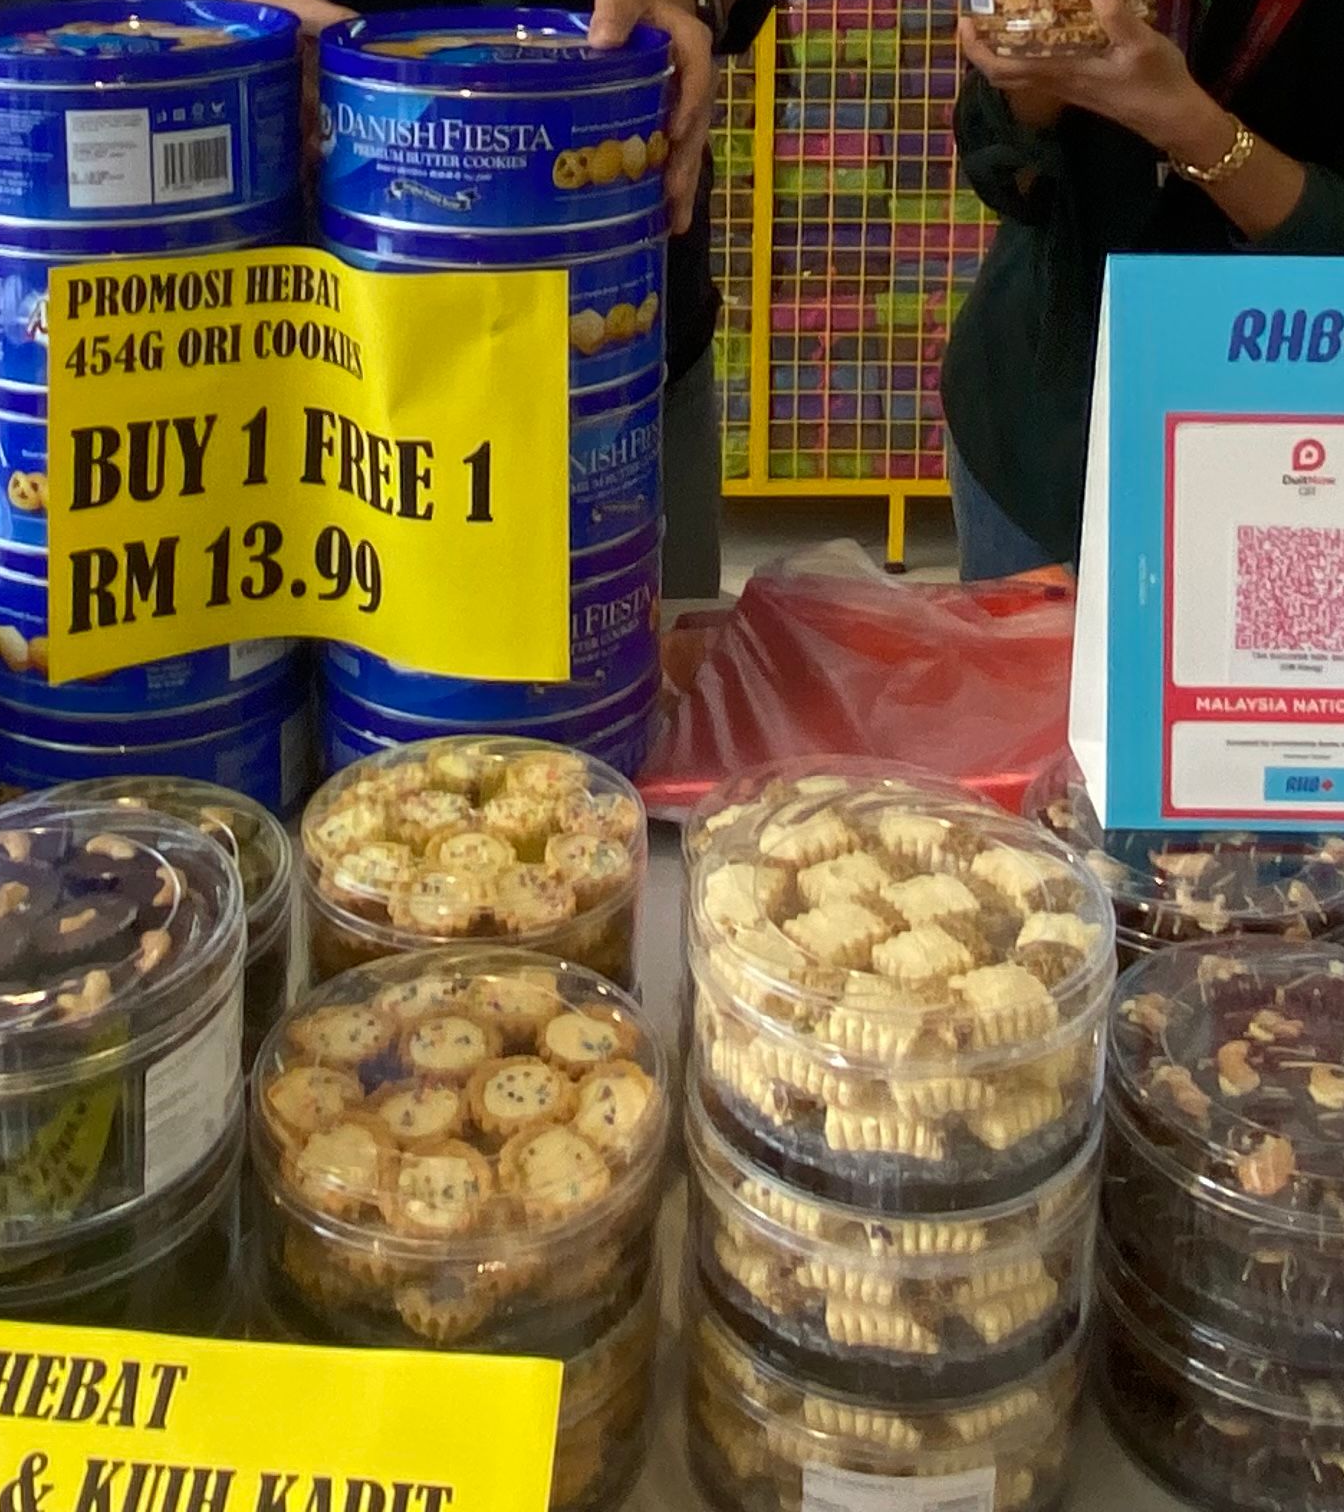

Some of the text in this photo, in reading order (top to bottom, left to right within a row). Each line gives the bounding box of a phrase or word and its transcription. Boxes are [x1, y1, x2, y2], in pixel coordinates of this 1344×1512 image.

[338, 100, 436, 151] DANISH
[441, 118, 554, 153] FIESTA
[406, 150, 459, 169] BUTTER
[462, 155, 528, 170] COOKIES
[67, 267, 234, 320] PROMOSI
[64, 318, 364, 381] 454G ORI COOKIES
[69, 406, 494, 523] BUY 1 FREE 1
[68, 520, 383, 635] RM 13.99
[1196, 696, 1287, 713] MALAYSIA
[1285, 775, 1321, 794] RHB
[75, 1458, 237, 1512] KUIH
